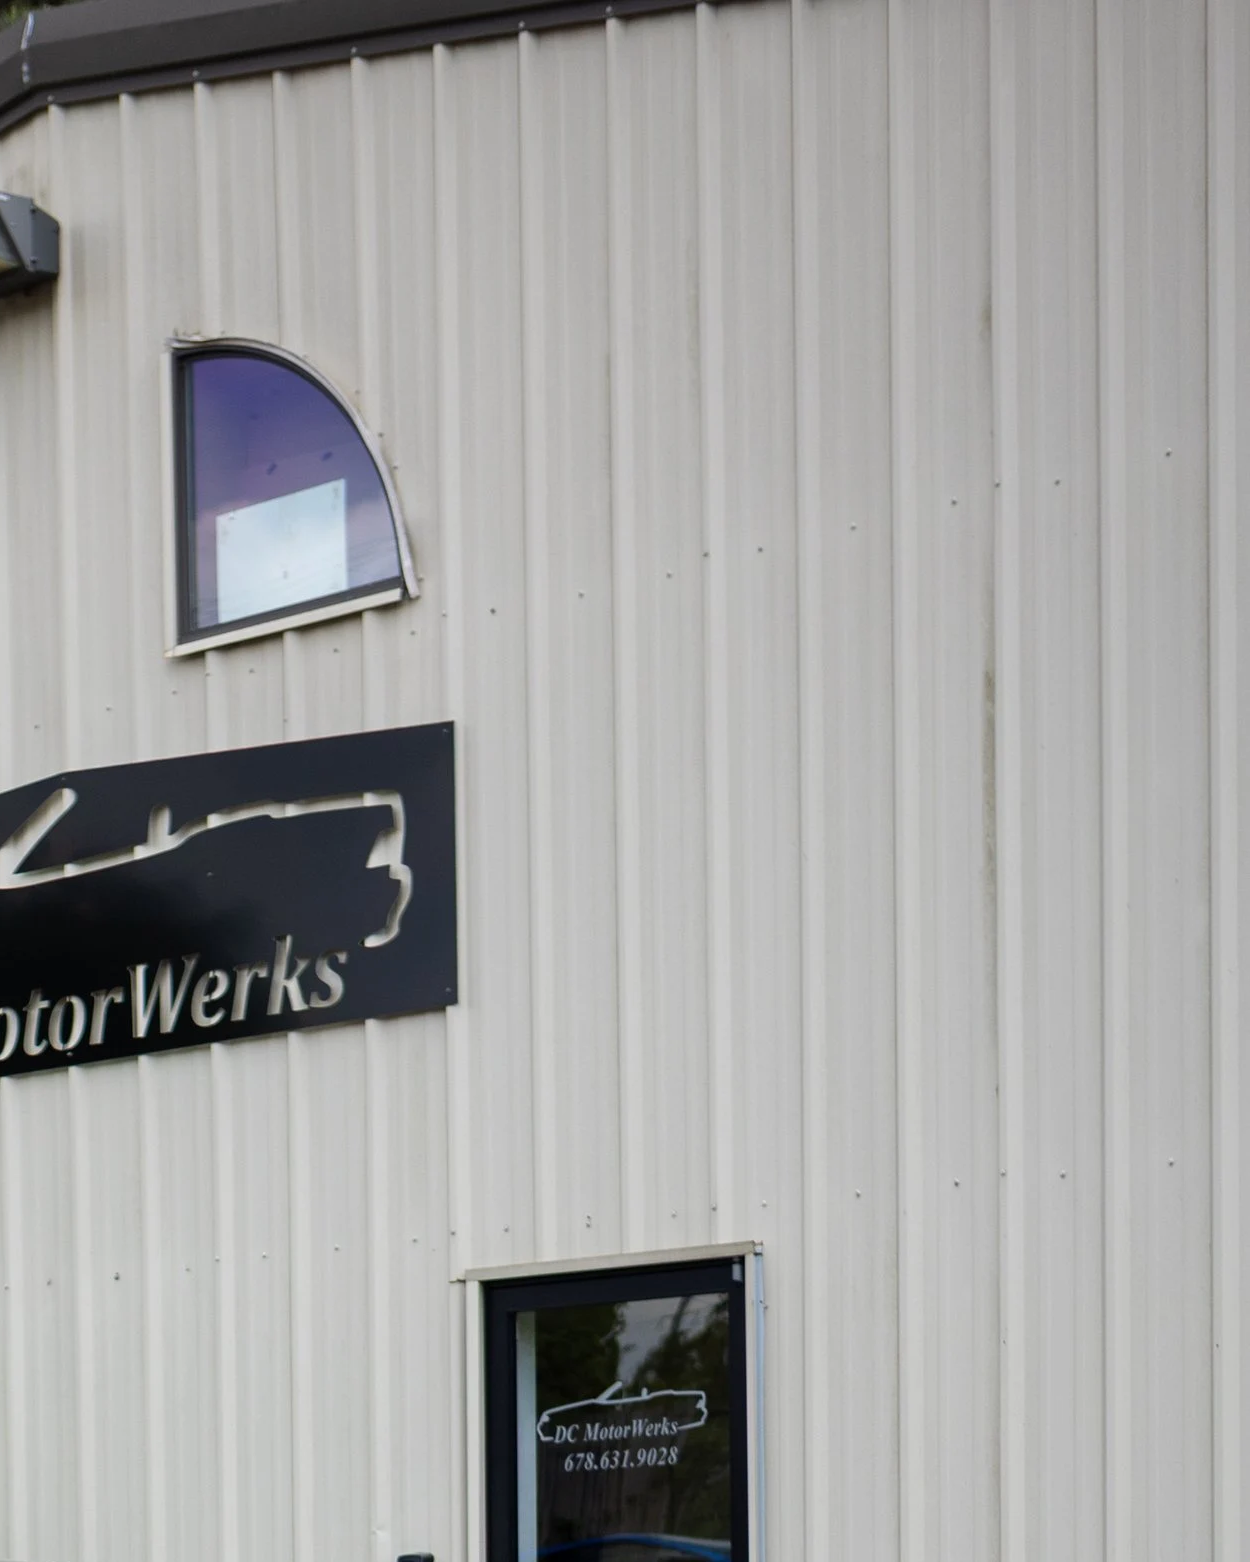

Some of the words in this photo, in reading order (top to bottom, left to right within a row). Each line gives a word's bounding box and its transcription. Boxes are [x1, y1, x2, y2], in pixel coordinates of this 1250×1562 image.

[554, 1424, 579, 1444] DC
[583, 1416, 678, 1442] MotorWerks
[564, 1446, 678, 1472] 678.631.9028
